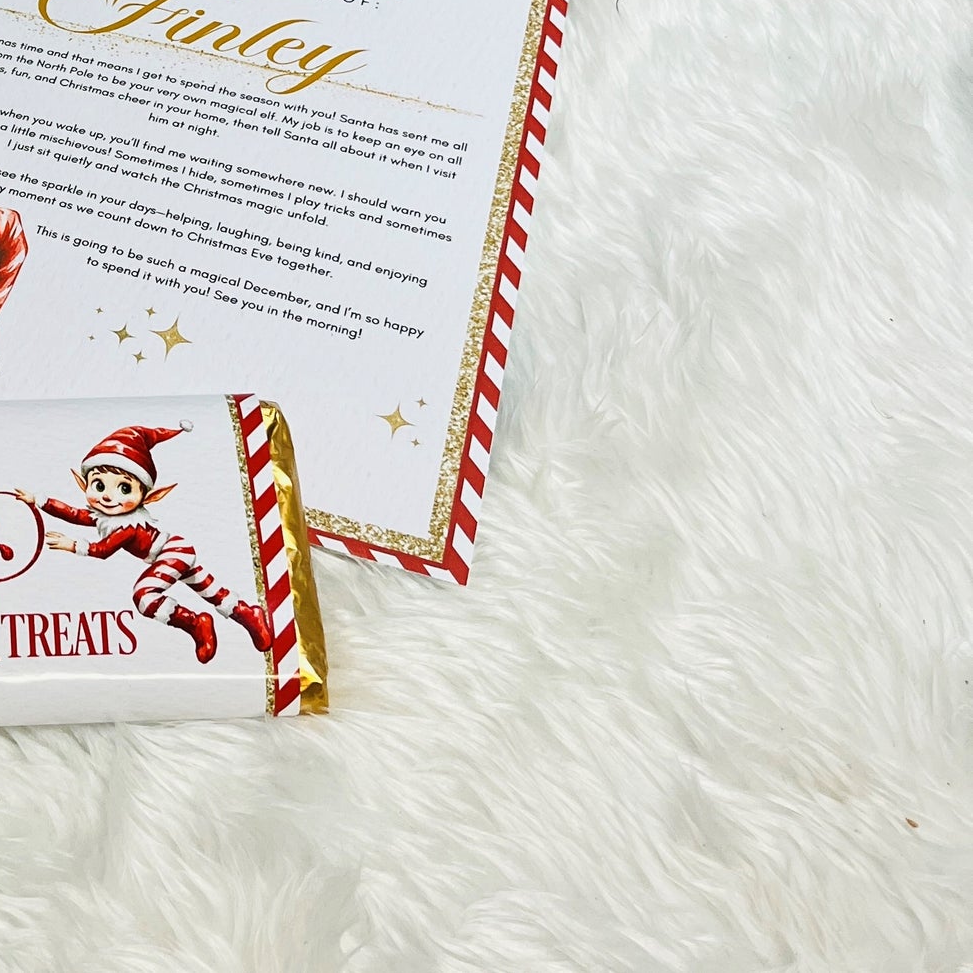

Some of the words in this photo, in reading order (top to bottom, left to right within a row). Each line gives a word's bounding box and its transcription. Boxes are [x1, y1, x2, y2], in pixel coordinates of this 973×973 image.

[11, 65, 32, 79] fun,
[34, 73, 59, 84] and
[59, 77, 116, 98] Christmas
[117, 91, 152, 105] cheer
[153, 101, 165, 109] in
[165, 104, 193, 115] your
[193, 107, 230, 126] home,
[233, 117, 260, 131] then
[262, 124, 282, 136] tell
[283, 129, 320, 146] Santa
[322, 139, 338, 150] all
[339, 143, 376, 159] about
[378, 153, 388, 162] it
[390, 156, 424, 171] when
[426, 163, 431, 172] I
[433, 168, 457, 179] visit
[20, 41, 45, 53] time
[46, 49, 70, 59] and
[71, 52, 95, 64] that
[96, 60, 134, 74] means
[136, 66, 142, 75] I
[141, 70, 163, 80] get
[165, 74, 178, 83] to
[179, 78, 217, 92] spend
[218, 85, 238, 97] the
[239, 92, 281, 107] season
[283, 102, 309, 114] with
[310, 108, 337, 119] you!
[339, 113, 375, 129] Santa
[378, 121, 400, 135] has
[402, 130, 428, 141] sent
[431, 137, 450, 147] me
[452, 141, 469, 152] all
[148, 111, 170, 125] him
[171, 120, 186, 128] at
[187, 123, 222, 137] night.
[0, 107, 31, 121] when
[31, 116, 54, 127] you
[56, 121, 87, 135] wake
[89, 129, 107, 141] up,
[109, 134, 141, 148] you'll
[142, 139, 167, 154] find
[167, 148, 187, 159] me
[189, 154, 234, 173] waiting
[236, 165, 306, 188] somewhere
[307, 183, 337, 196] new.
[340, 188, 346, 198] I
[347, 191, 389, 209] should
[391, 204, 422, 218] warn
[424, 212, 447, 224] you
[7, 138, 13, 147] I
[12, 142, 36, 152] just
[36, 147, 52, 156] sit
[53, 151, 94, 169] quietly
[95, 161, 120, 173] and
[121, 167, 158, 183] watch
[161, 175, 181, 188] the
[183, 181, 243, 205] Christmas
[245, 199, 285, 215] magic
[287, 209, 331, 227] unfold.
[8, 187, 58, 205] moment
[58, 200, 74, 210] as
[76, 203, 95, 215] we
[97, 209, 132, 224] count
[134, 217, 168, 234] down
[171, 226, 184, 238] to
[187, 230, 248, 255] Christmas
[250, 246, 274, 261] Eve
[277, 254, 333, 278] together.
[20, 172, 40, 185] the
[41, 179, 84, 196] sparkle
[86, 190, 98, 199] in
[99, 194, 127, 206] your
[216, 220, 273, 246] laughing,
[276, 236, 312, 257] being
[314, 246, 344, 265] kind,
[346, 258, 373, 271] and
[374, 265, 429, 288] enjoying
[36, 223, 59, 239] This
[60, 233, 71, 242] is
[72, 236, 109, 254] going
[112, 244, 125, 256] to
[127, 247, 144, 261] be
[146, 255, 176, 269] such
[178, 264, 188, 272] a
[190, 267, 242, 287] magical
[243, 279, 312, 308] December,
[315, 301, 342, 314] and
[343, 306, 363, 320] I'm
[365, 315, 381, 325] so
[383, 315, 425, 339] happy
[86, 255, 100, 267] to
[101, 261, 142, 278] spend
[142, 271, 153, 280] it
[155, 275, 181, 289] with
[182, 283, 212, 297] you!
[213, 288, 239, 304] See
[240, 298, 265, 312] you
[267, 306, 279, 316] in
[282, 308, 304, 322] the
[306, 317, 363, 340] morning!
[0, 609, 138, 659] TREATS
